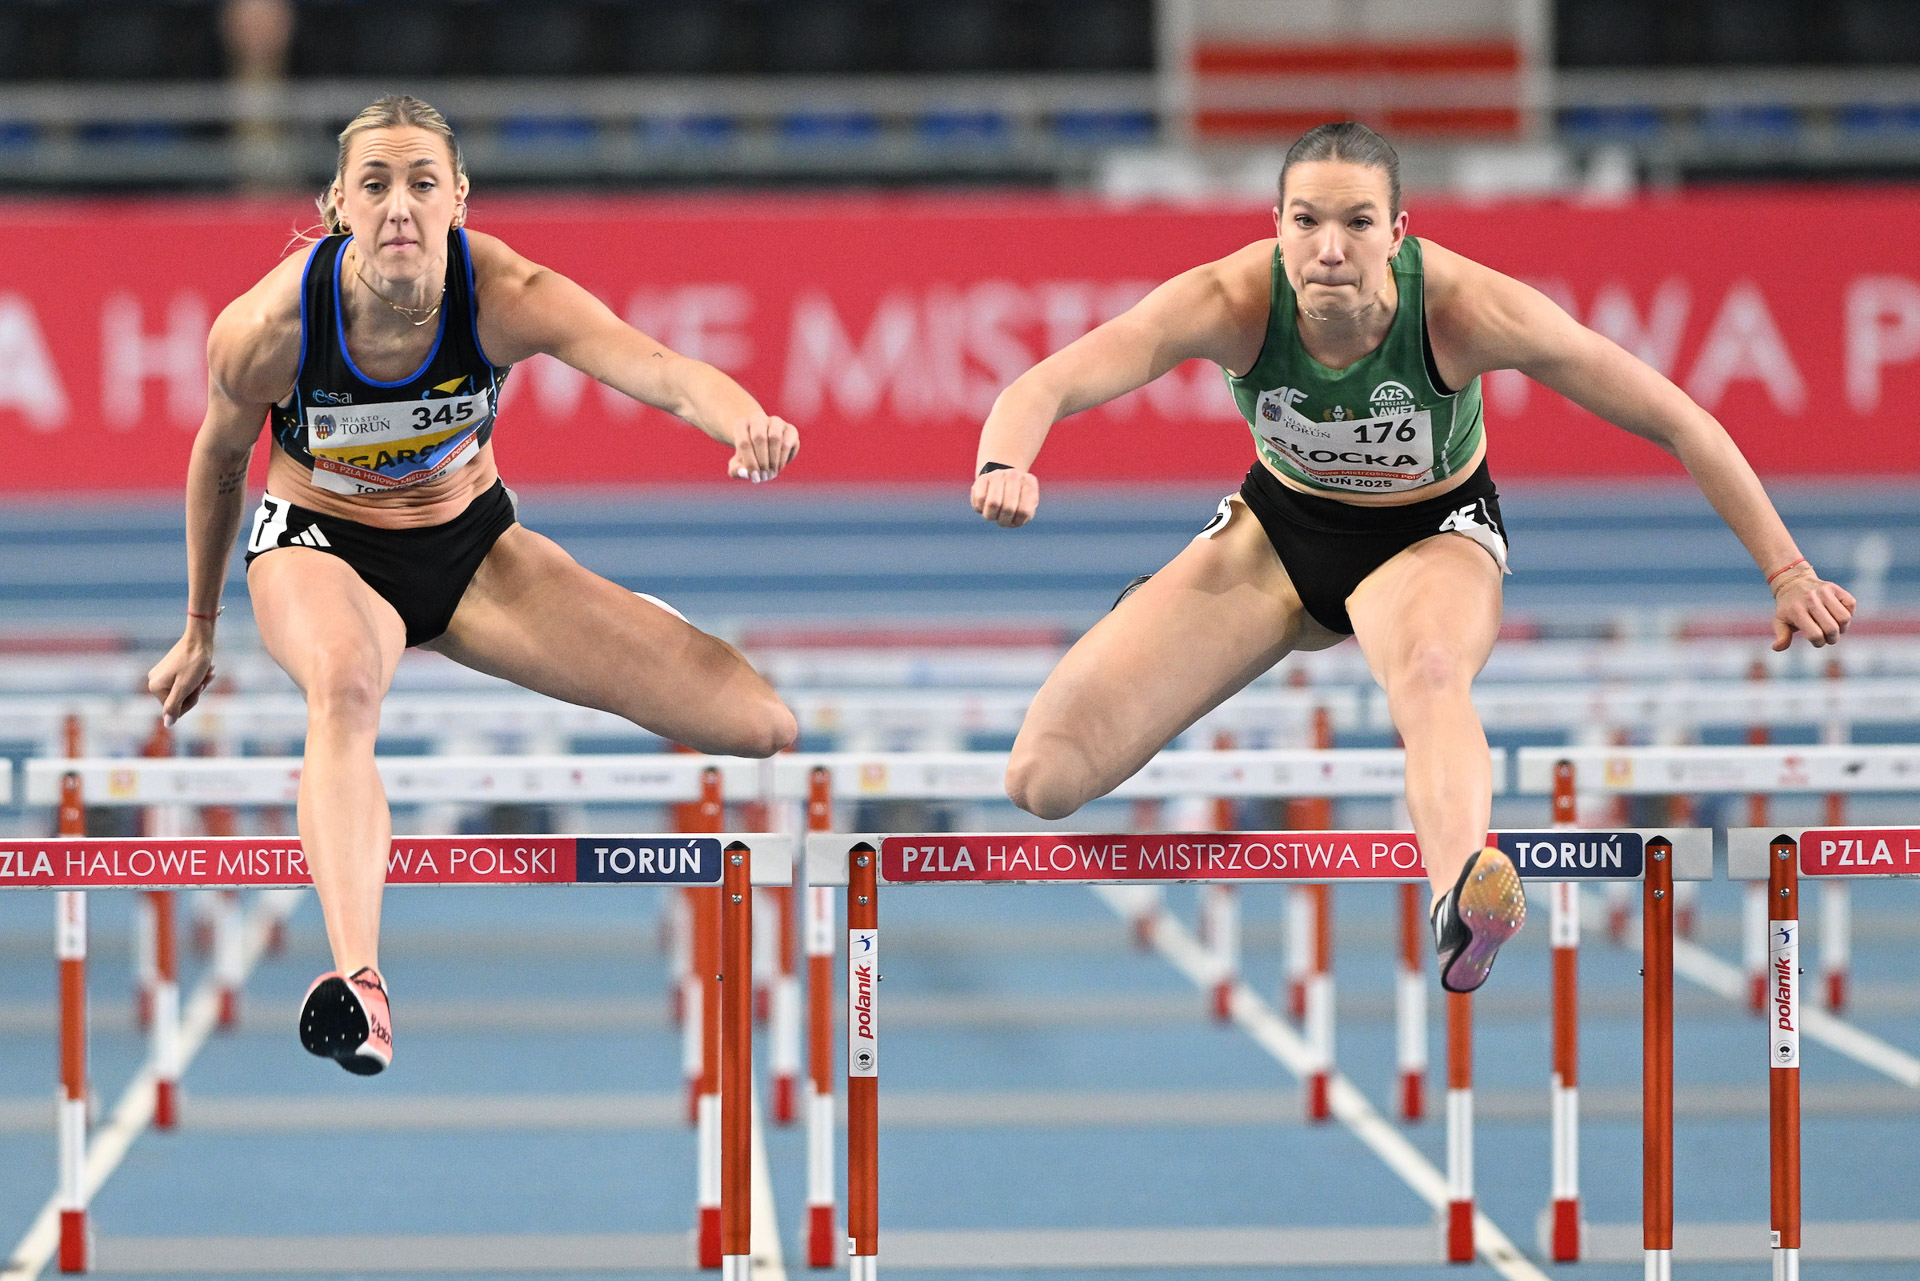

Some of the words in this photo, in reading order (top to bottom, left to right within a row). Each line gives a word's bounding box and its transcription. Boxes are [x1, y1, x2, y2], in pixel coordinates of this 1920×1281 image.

[1379, 389, 1404, 400] AZS
[339, 417, 391, 435] TORUŃ
[341, 415, 379, 424] MIASTO
[412, 401, 474, 431] 345
[1353, 418, 1417, 444] 176
[1271, 436, 1419, 467] SŁOCKA
[340, 466, 361, 477] PZLA
[1355, 479, 1392, 488] 2025
[255, 499, 278, 548] 7
[66, 849, 206, 877] HALOWE
[217, 847, 438, 876] MISTRWA
[450, 847, 556, 875] POLSKI
[594, 840, 700, 874] TORUŃ
[902, 845, 976, 873] PZLA
[987, 844, 1127, 871] HALOWE
[1138, 842, 1361, 870] MISTRZOSTWA
[1515, 834, 1622, 869] TORUŃ
[1821, 839, 1894, 866] PZLA
[855, 963, 874, 1040] polanik
[1774, 956, 1795, 1032] polanik
